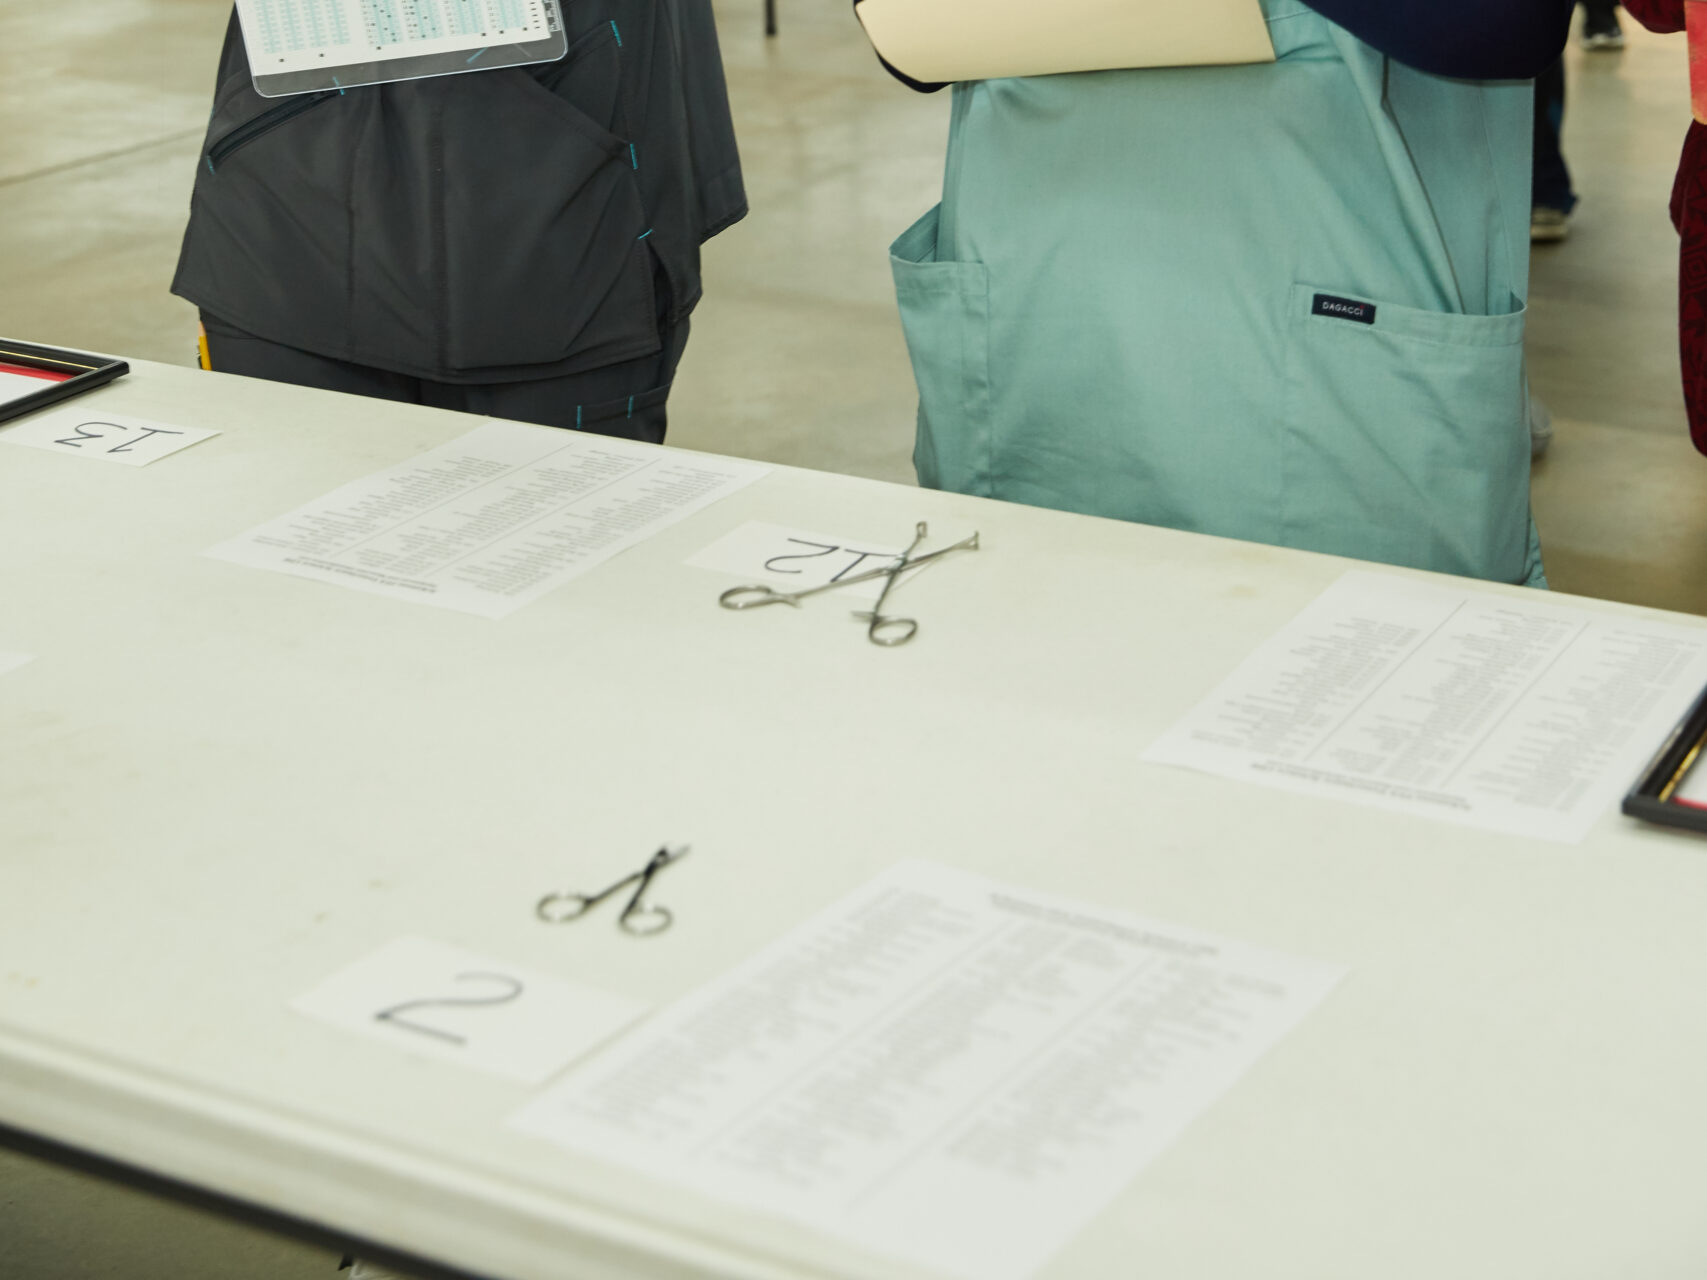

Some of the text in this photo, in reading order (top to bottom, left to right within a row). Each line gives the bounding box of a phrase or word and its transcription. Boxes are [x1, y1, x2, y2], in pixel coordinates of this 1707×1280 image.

[1322, 301, 1364, 317] DAGACCI
[53, 421, 184, 453] 13
[374, 972, 524, 1046] 2
